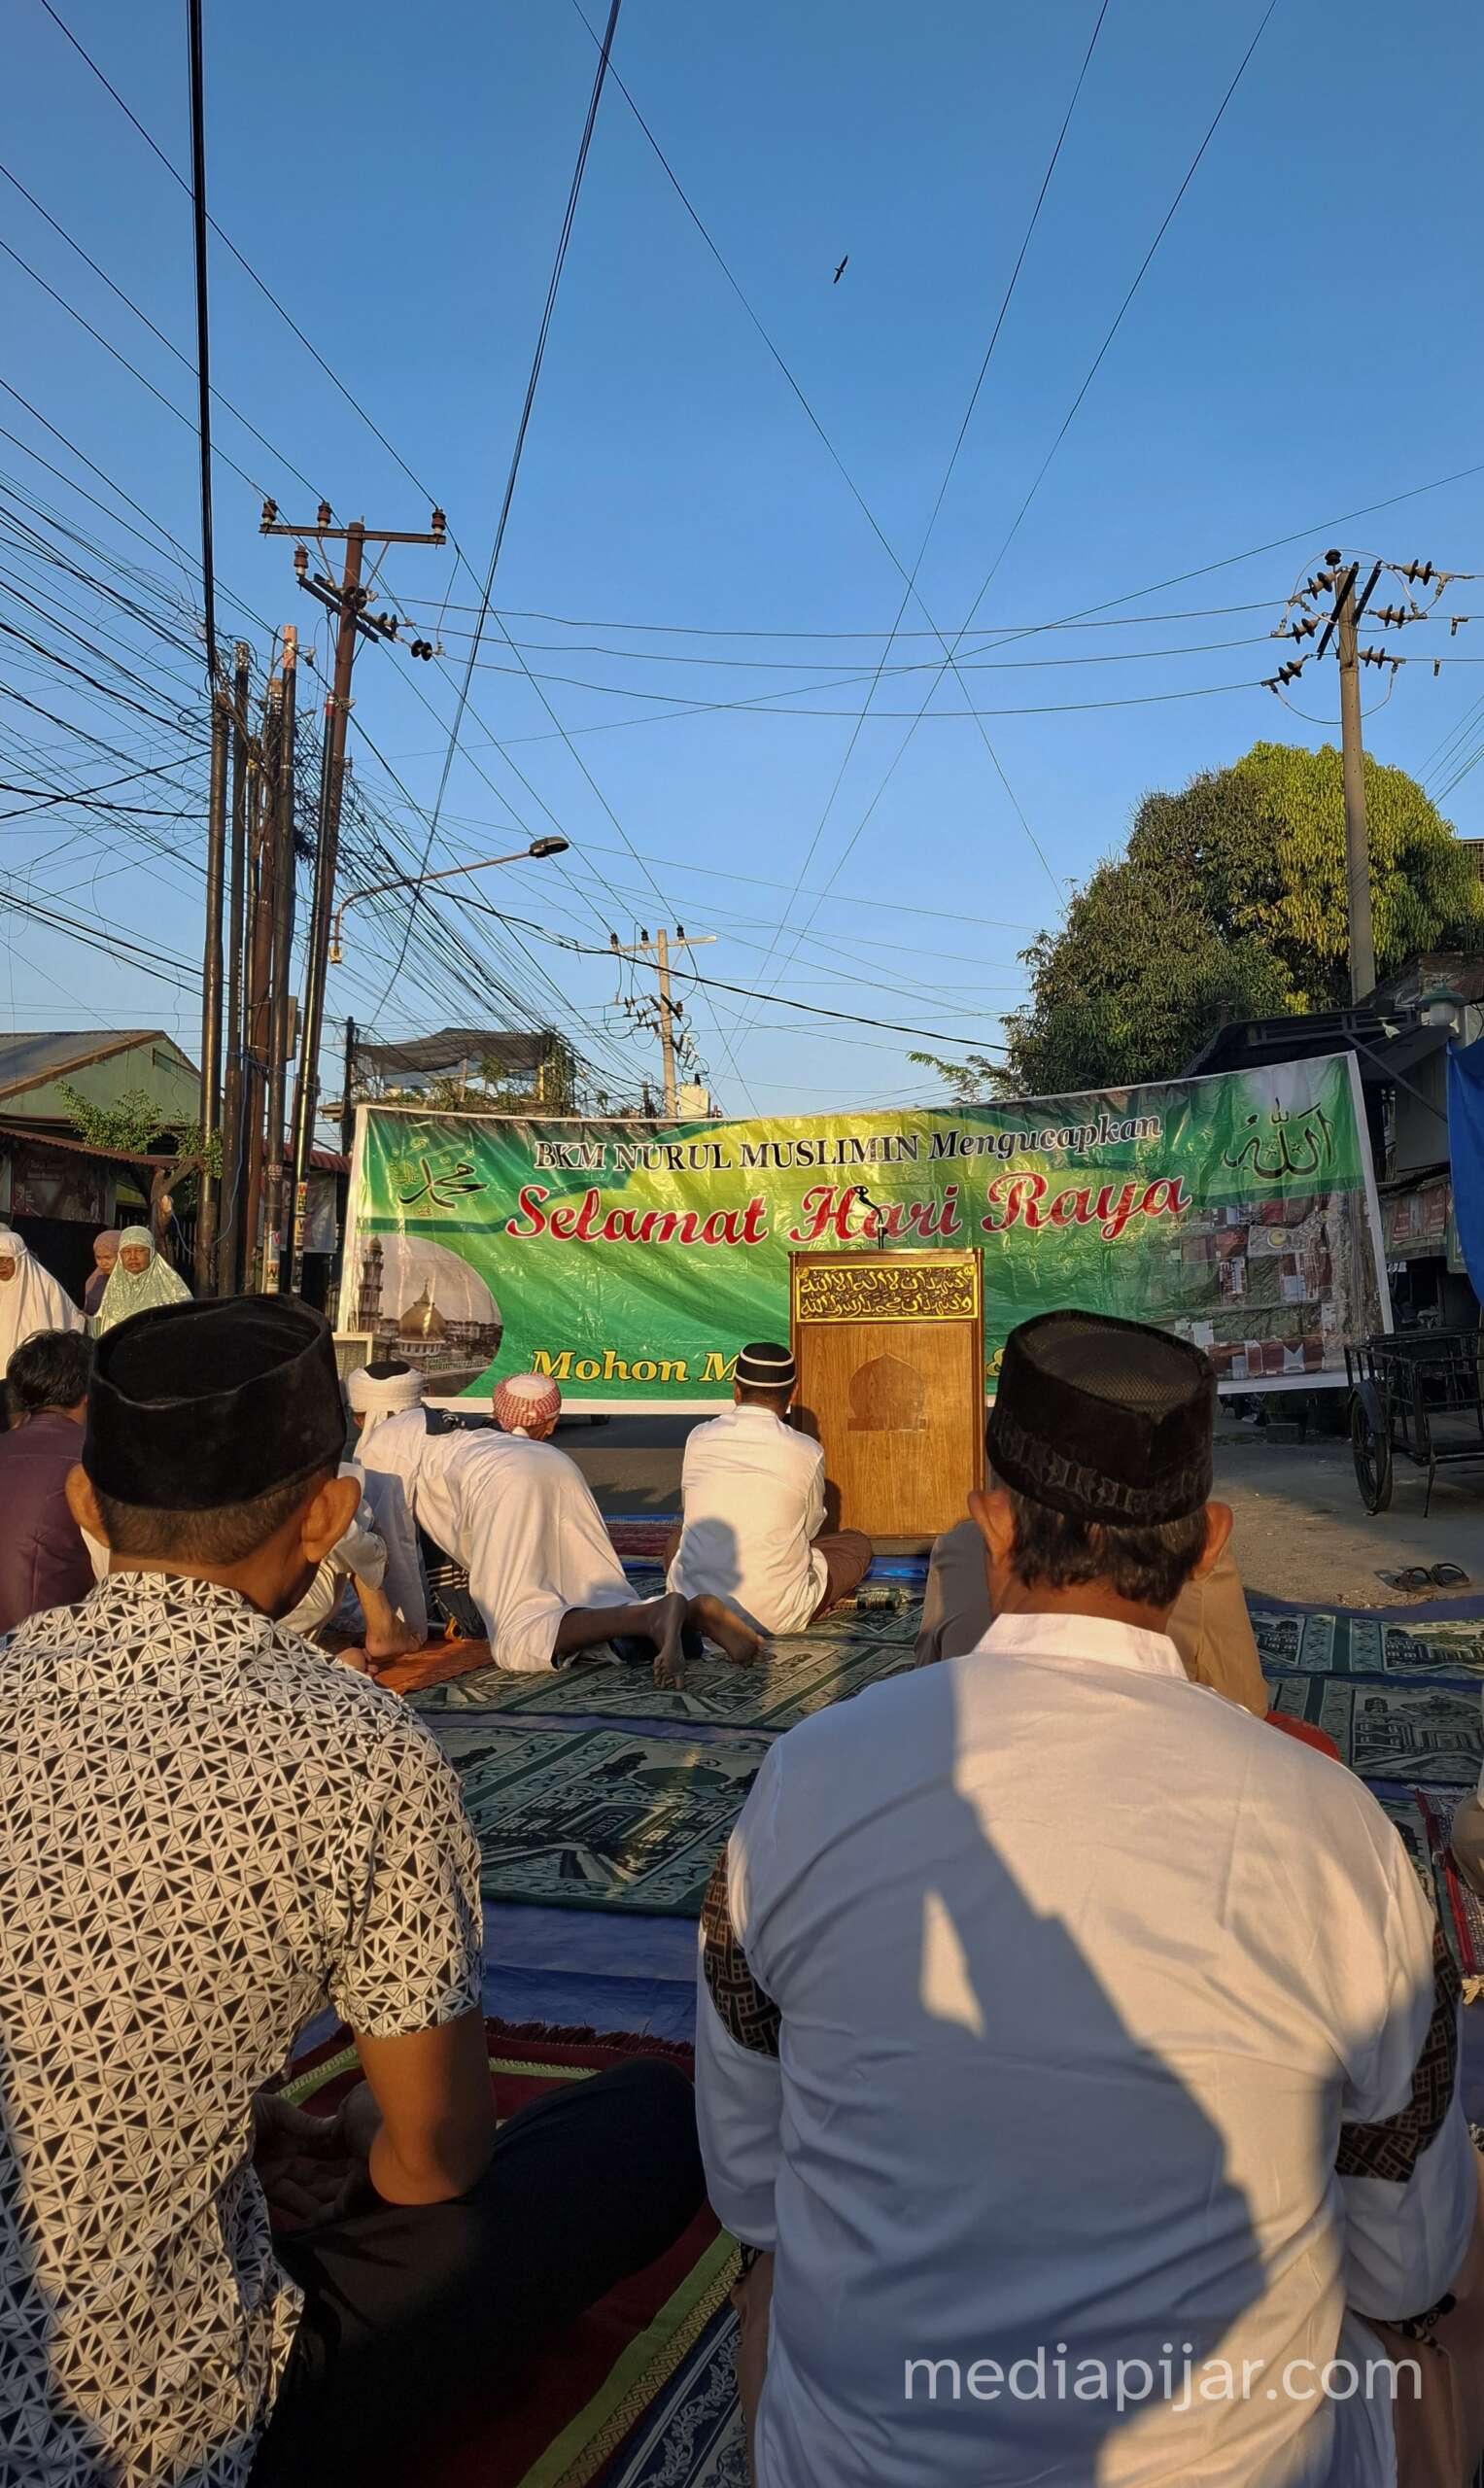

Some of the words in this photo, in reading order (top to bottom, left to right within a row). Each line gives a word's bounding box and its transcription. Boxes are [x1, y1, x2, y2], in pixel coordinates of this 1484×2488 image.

[535, 1141, 606, 1171] BKM
[613, 1143, 732, 1172] NURUL
[740, 1134, 920, 1172] MUSLIMIN
[928, 1112, 1162, 1161] Mengucapkan
[505, 1185, 769, 1247] Selamat
[788, 1183, 963, 1244] Hari
[982, 1172, 1192, 1243] Raya
[533, 1349, 690, 1383] Mohon
